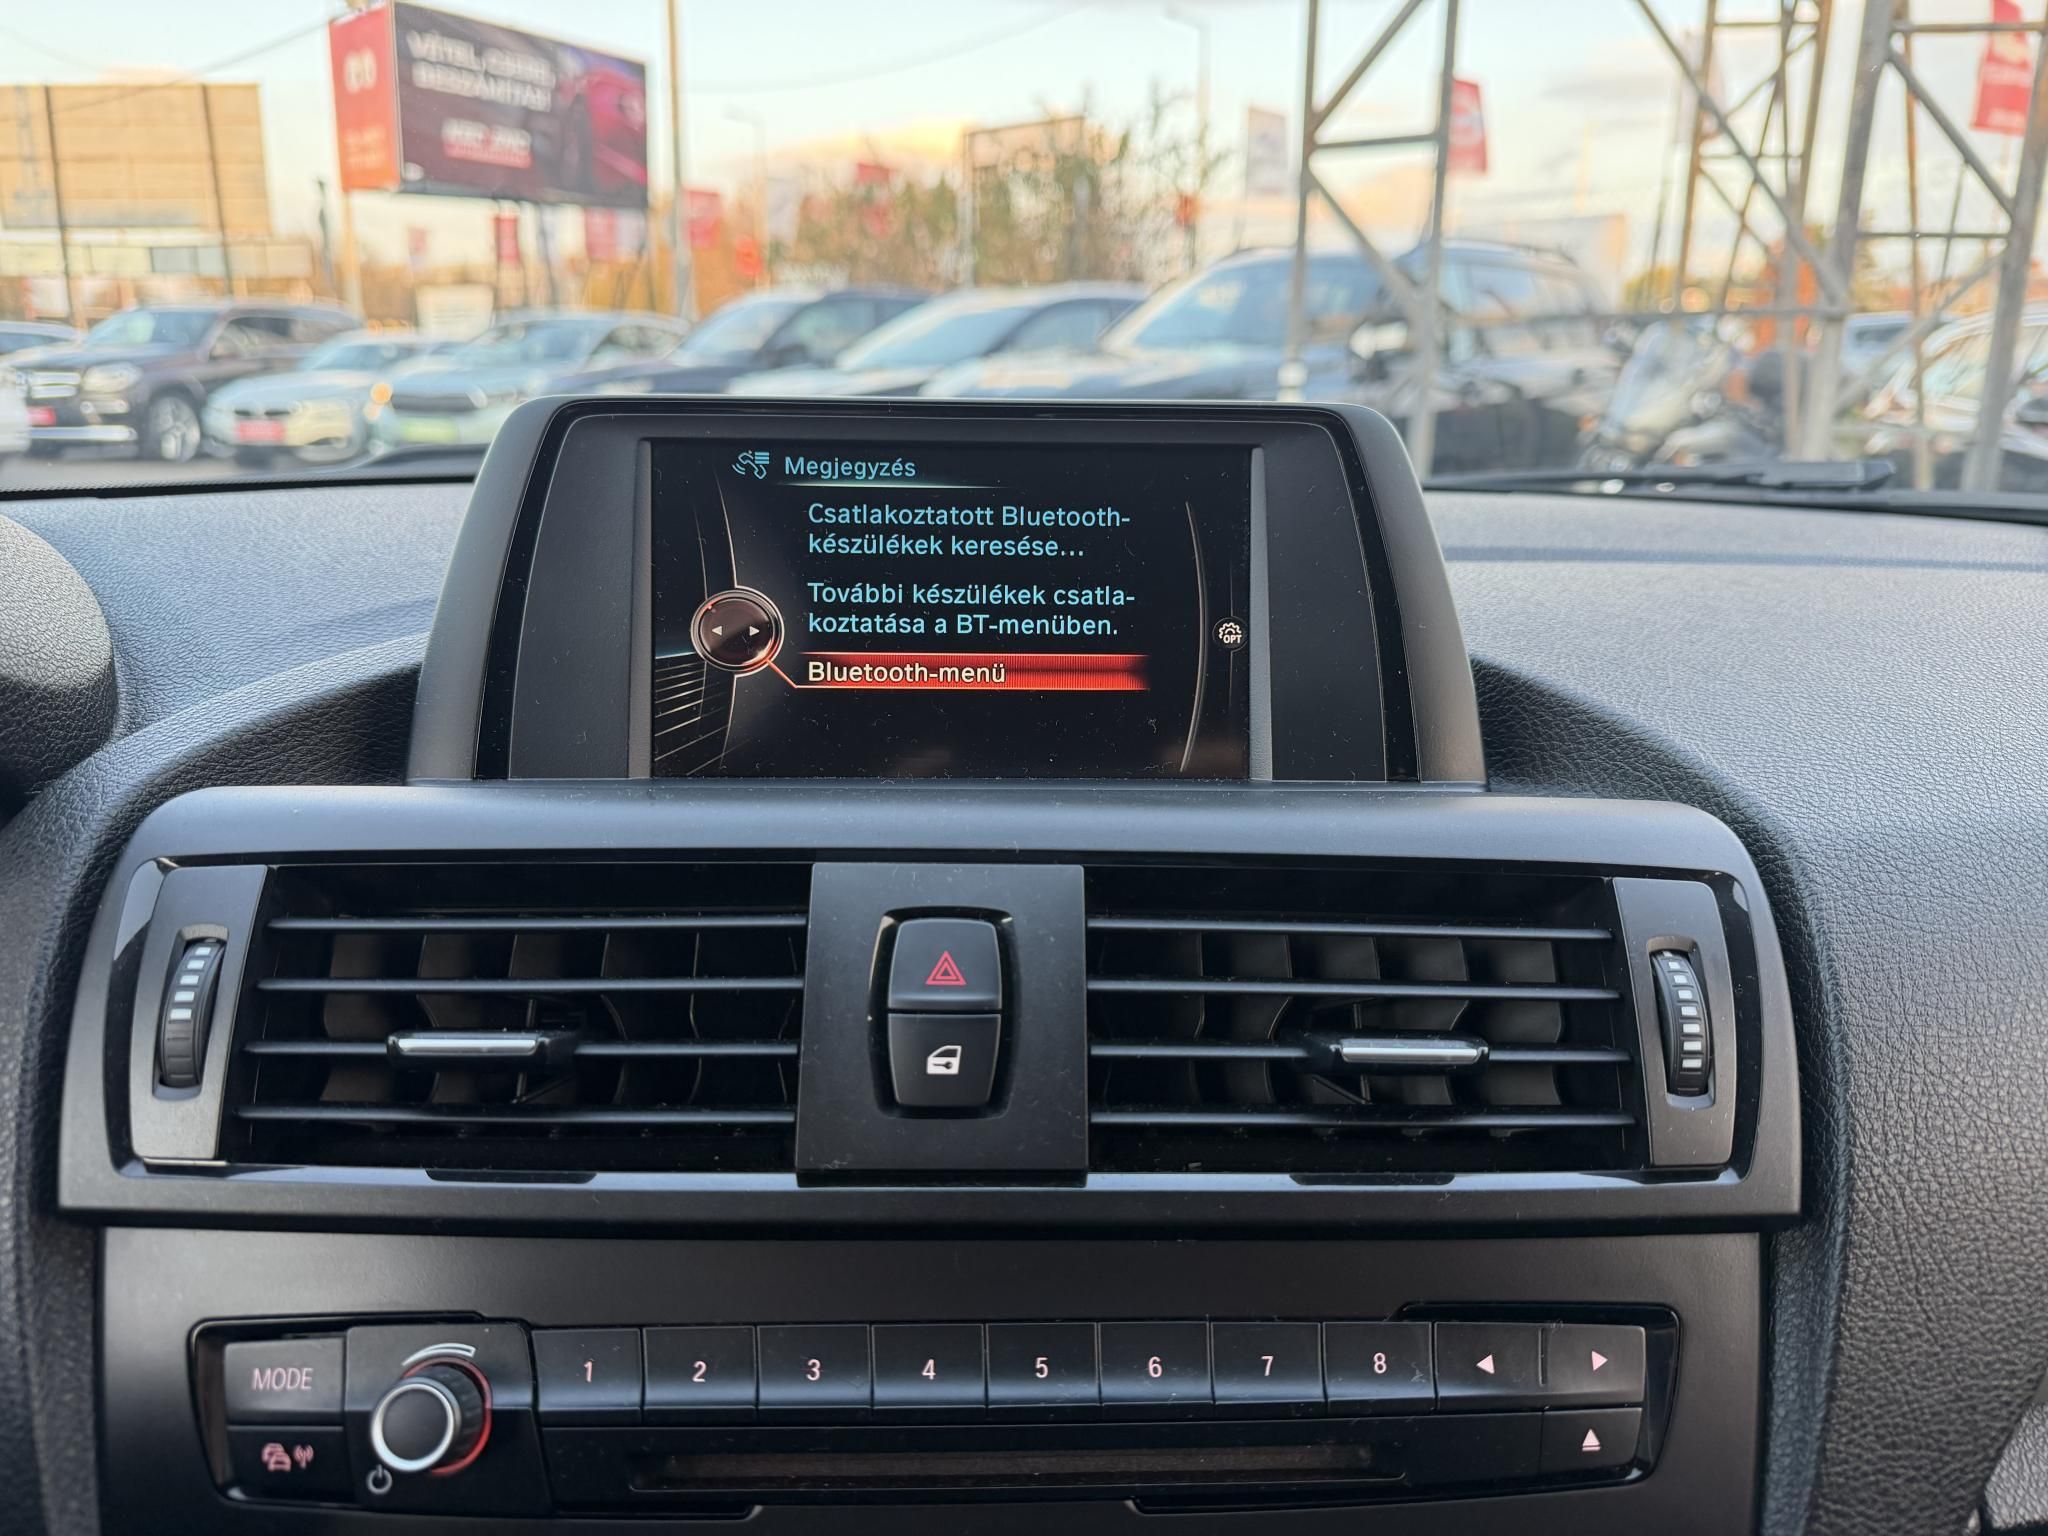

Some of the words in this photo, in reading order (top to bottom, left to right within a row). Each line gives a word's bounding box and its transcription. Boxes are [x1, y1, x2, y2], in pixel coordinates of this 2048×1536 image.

[785, 456, 916, 480] Megjegyzés
[808, 503, 994, 526] Csatlakoztatott
[1003, 505, 1131, 527] Bluetooth-
[809, 532, 944, 555] készülékek
[808, 582, 903, 604] További
[913, 583, 1046, 605] készülékek
[1054, 585, 1135, 606] csatla-
[808, 612, 925, 634] koztatása
[935, 618, 947, 634] a
[957, 613, 1118, 635] BT-menüben.
[1223, 634, 1242, 644] OPT
[808, 661, 1006, 685] Bluetooth-menü
[583, 1361, 593, 1382] 1
[692, 1360, 707, 1382] 2
[807, 1358, 821, 1380] 3
[921, 1359, 936, 1380] 4
[1035, 1357, 1049, 1378] 5
[1148, 1356, 1162, 1378] 6
[1261, 1355, 1273, 1376] 7
[1373, 1353, 1387, 1374] 8
[253, 1367, 312, 1391] MODE
